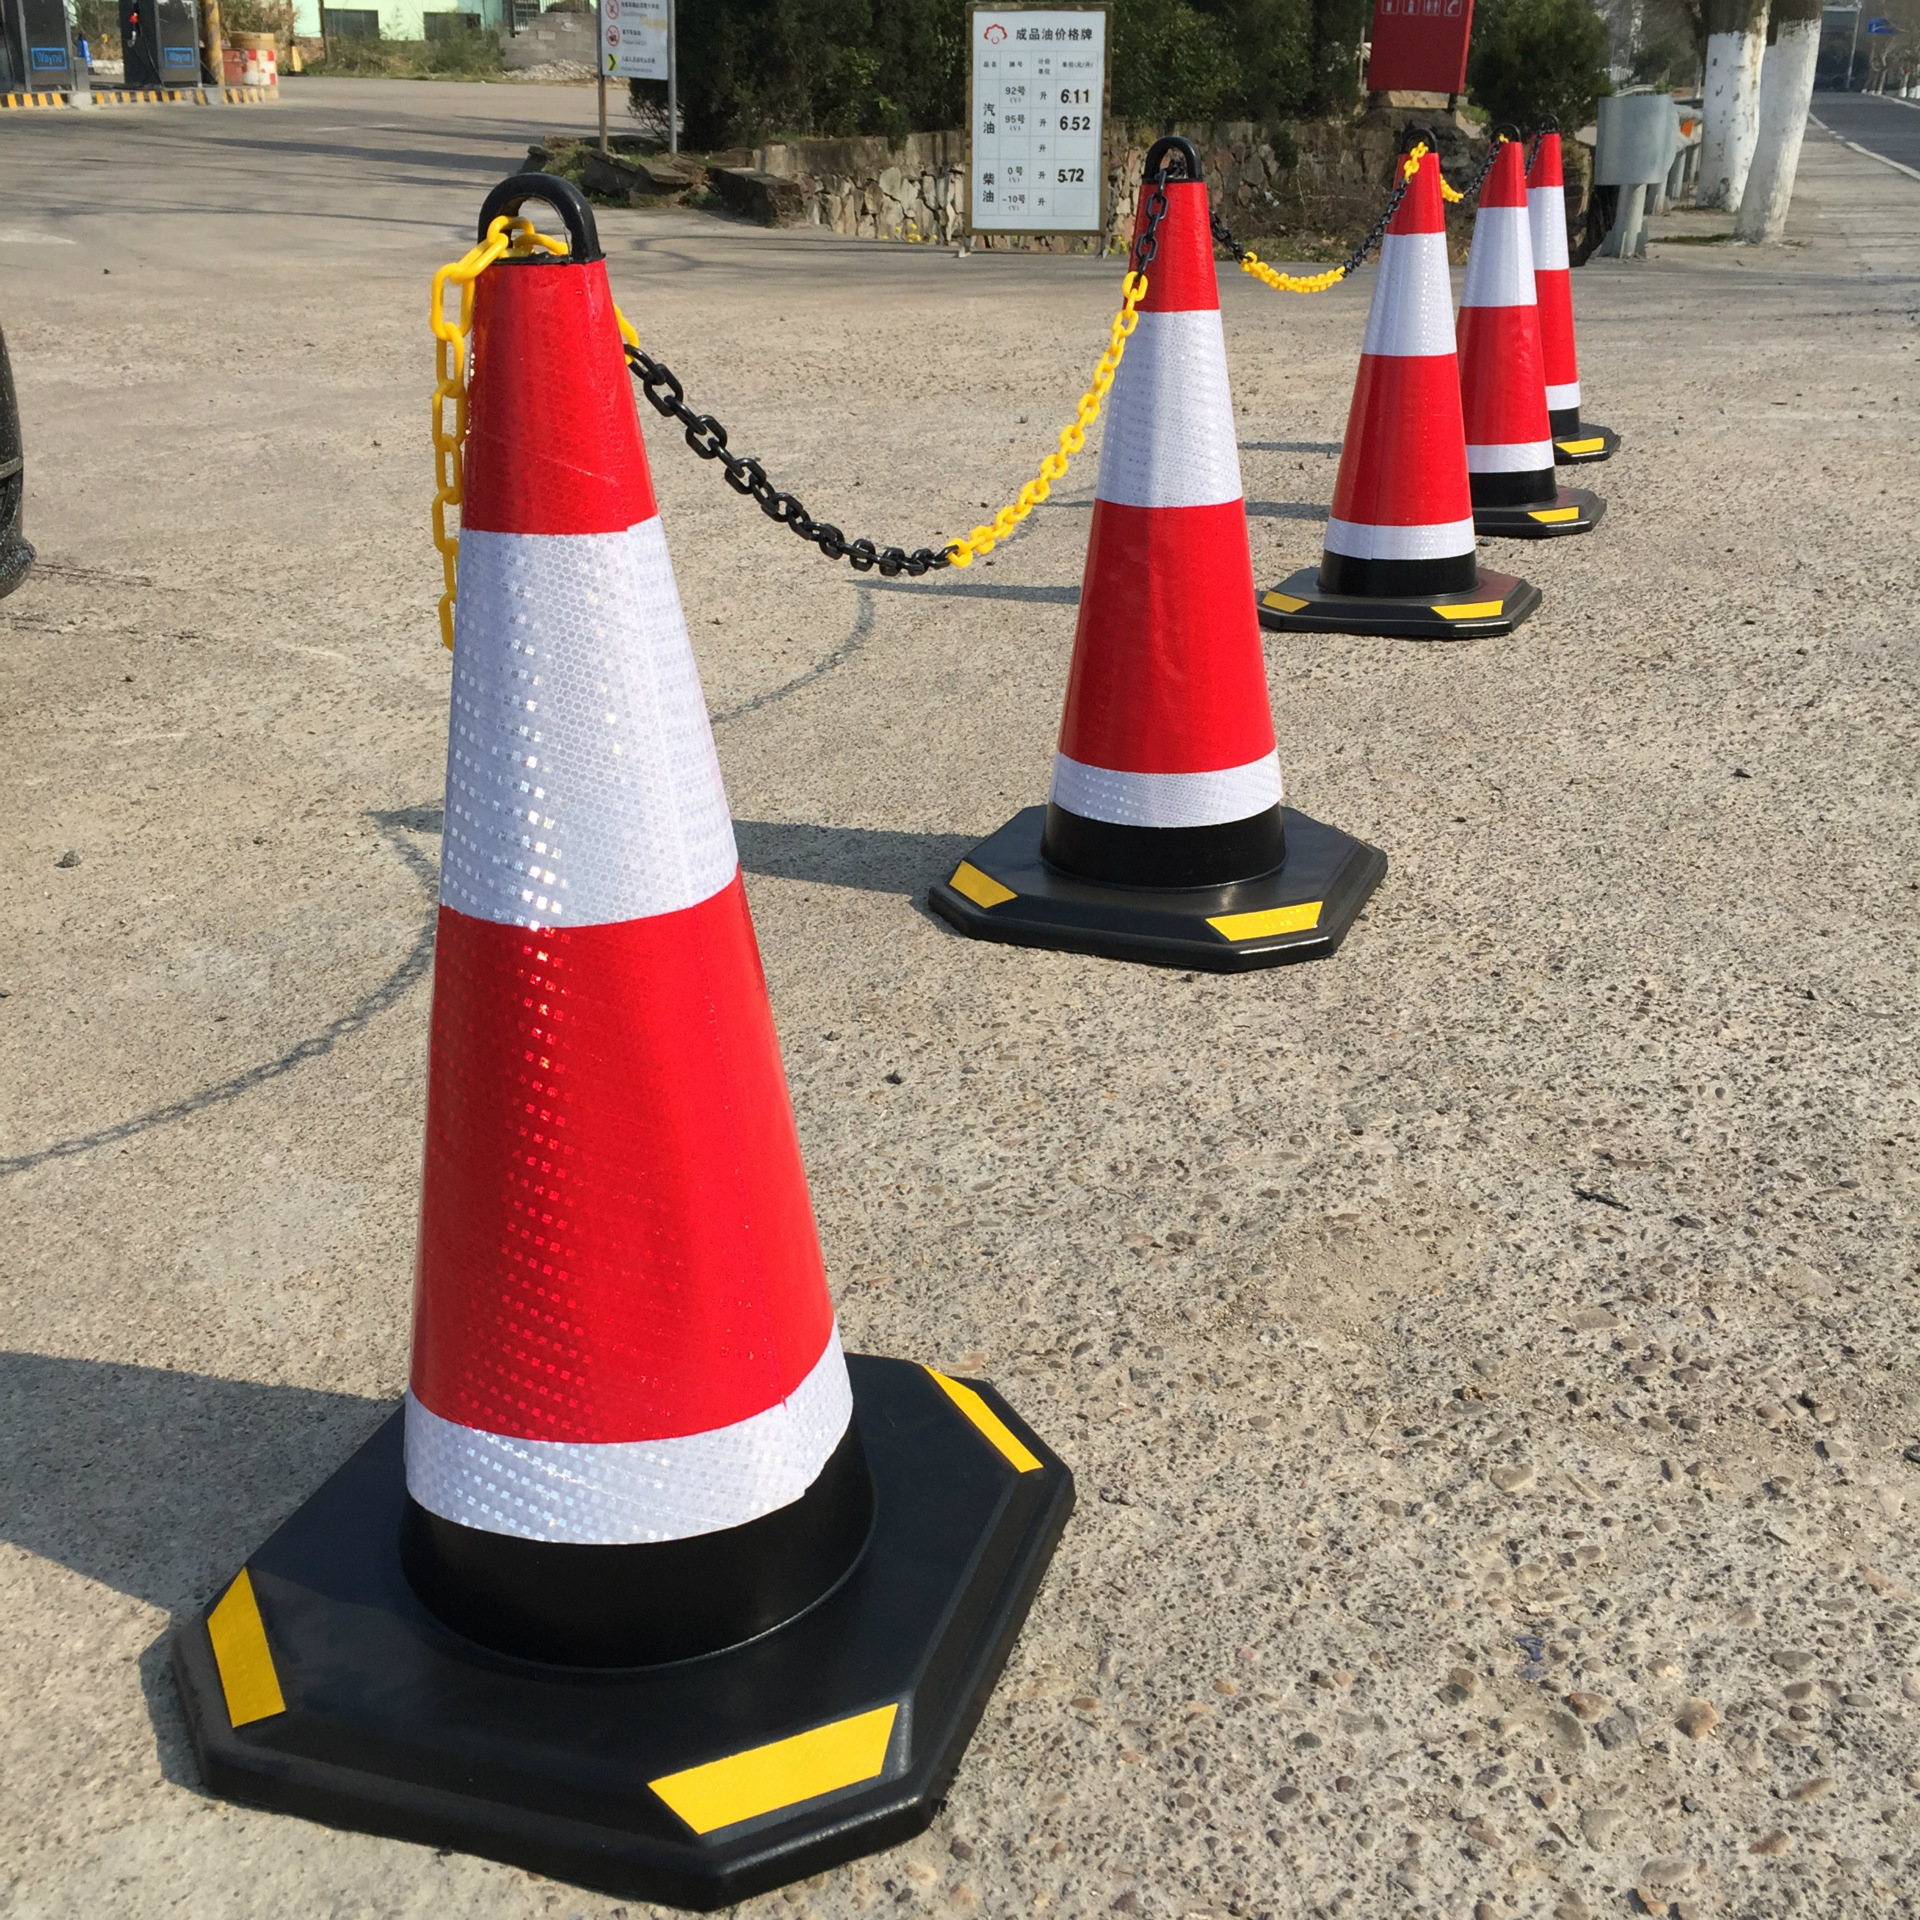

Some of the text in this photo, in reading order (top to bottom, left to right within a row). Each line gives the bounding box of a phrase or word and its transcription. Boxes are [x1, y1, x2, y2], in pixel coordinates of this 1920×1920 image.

[1016, 28, 1093, 41] 成品油价格牌
[35, 51, 62, 65] Wayne
[169, 51, 190, 64] Wayne
[1005, 86, 1026, 96] 92号
[1040, 91, 1047, 100] 升
[1060, 88, 1090, 104] 6.11
[1005, 114, 1025, 124] 95号
[1039, 118, 1047, 128] 升
[1059, 115, 1091, 131] 6.52
[1038, 144, 1046, 152] 升
[1038, 171, 1046, 180] 升
[1057, 168, 1085, 183] 5.72
[1038, 197, 1045, 206] 升
